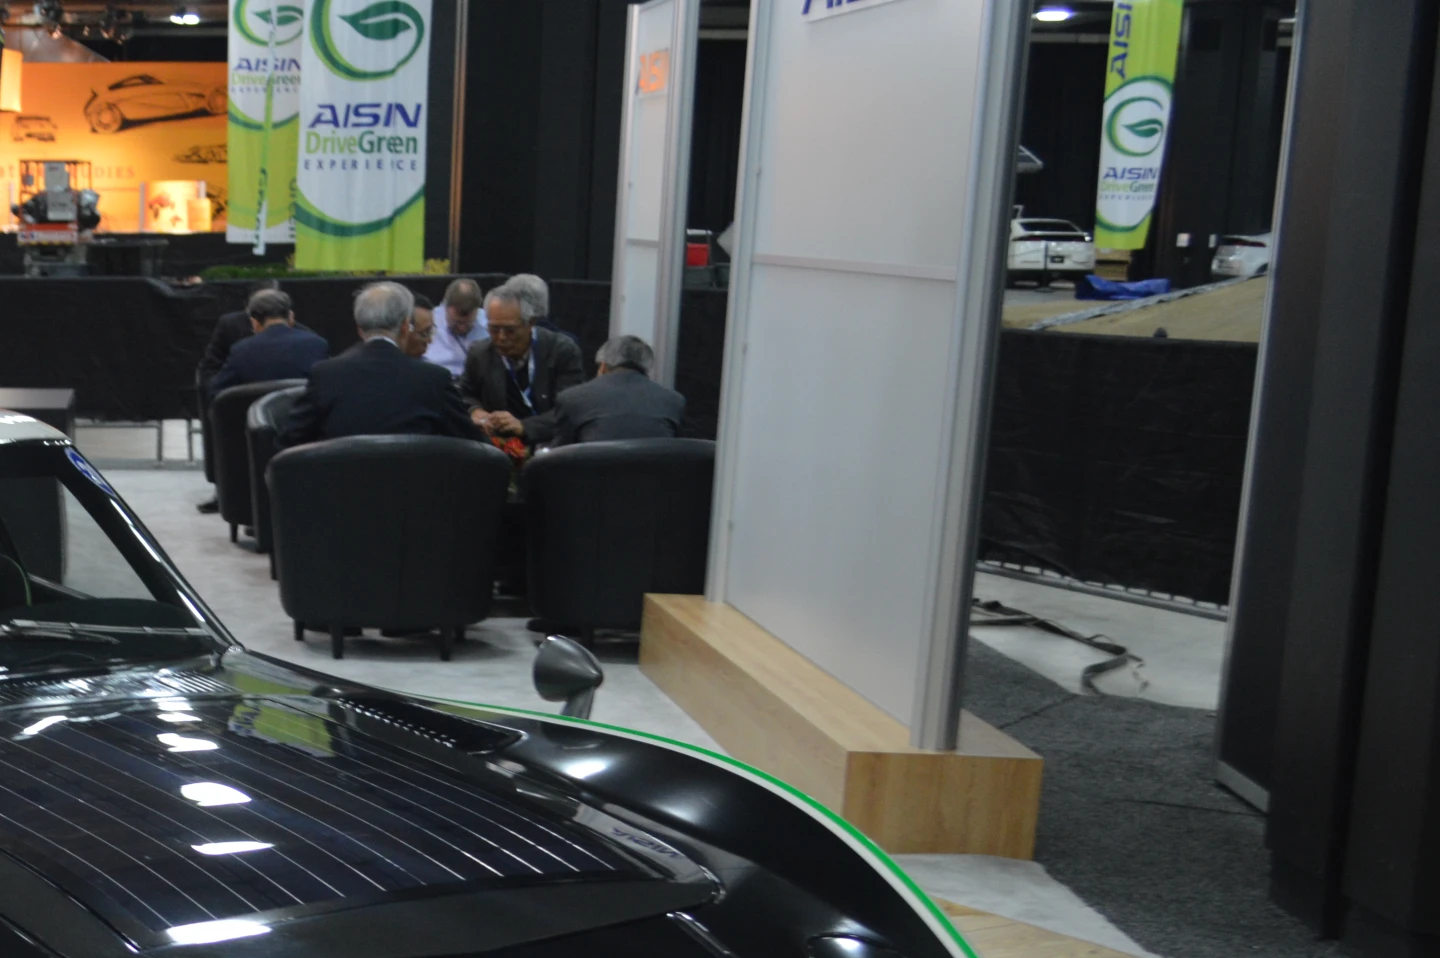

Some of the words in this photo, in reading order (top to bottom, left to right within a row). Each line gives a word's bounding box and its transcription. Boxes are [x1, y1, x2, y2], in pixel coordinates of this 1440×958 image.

[308, 103, 422, 128] AISIN
[305, 131, 418, 154] DriveGreen
[1103, 166, 1158, 180] AISIN
